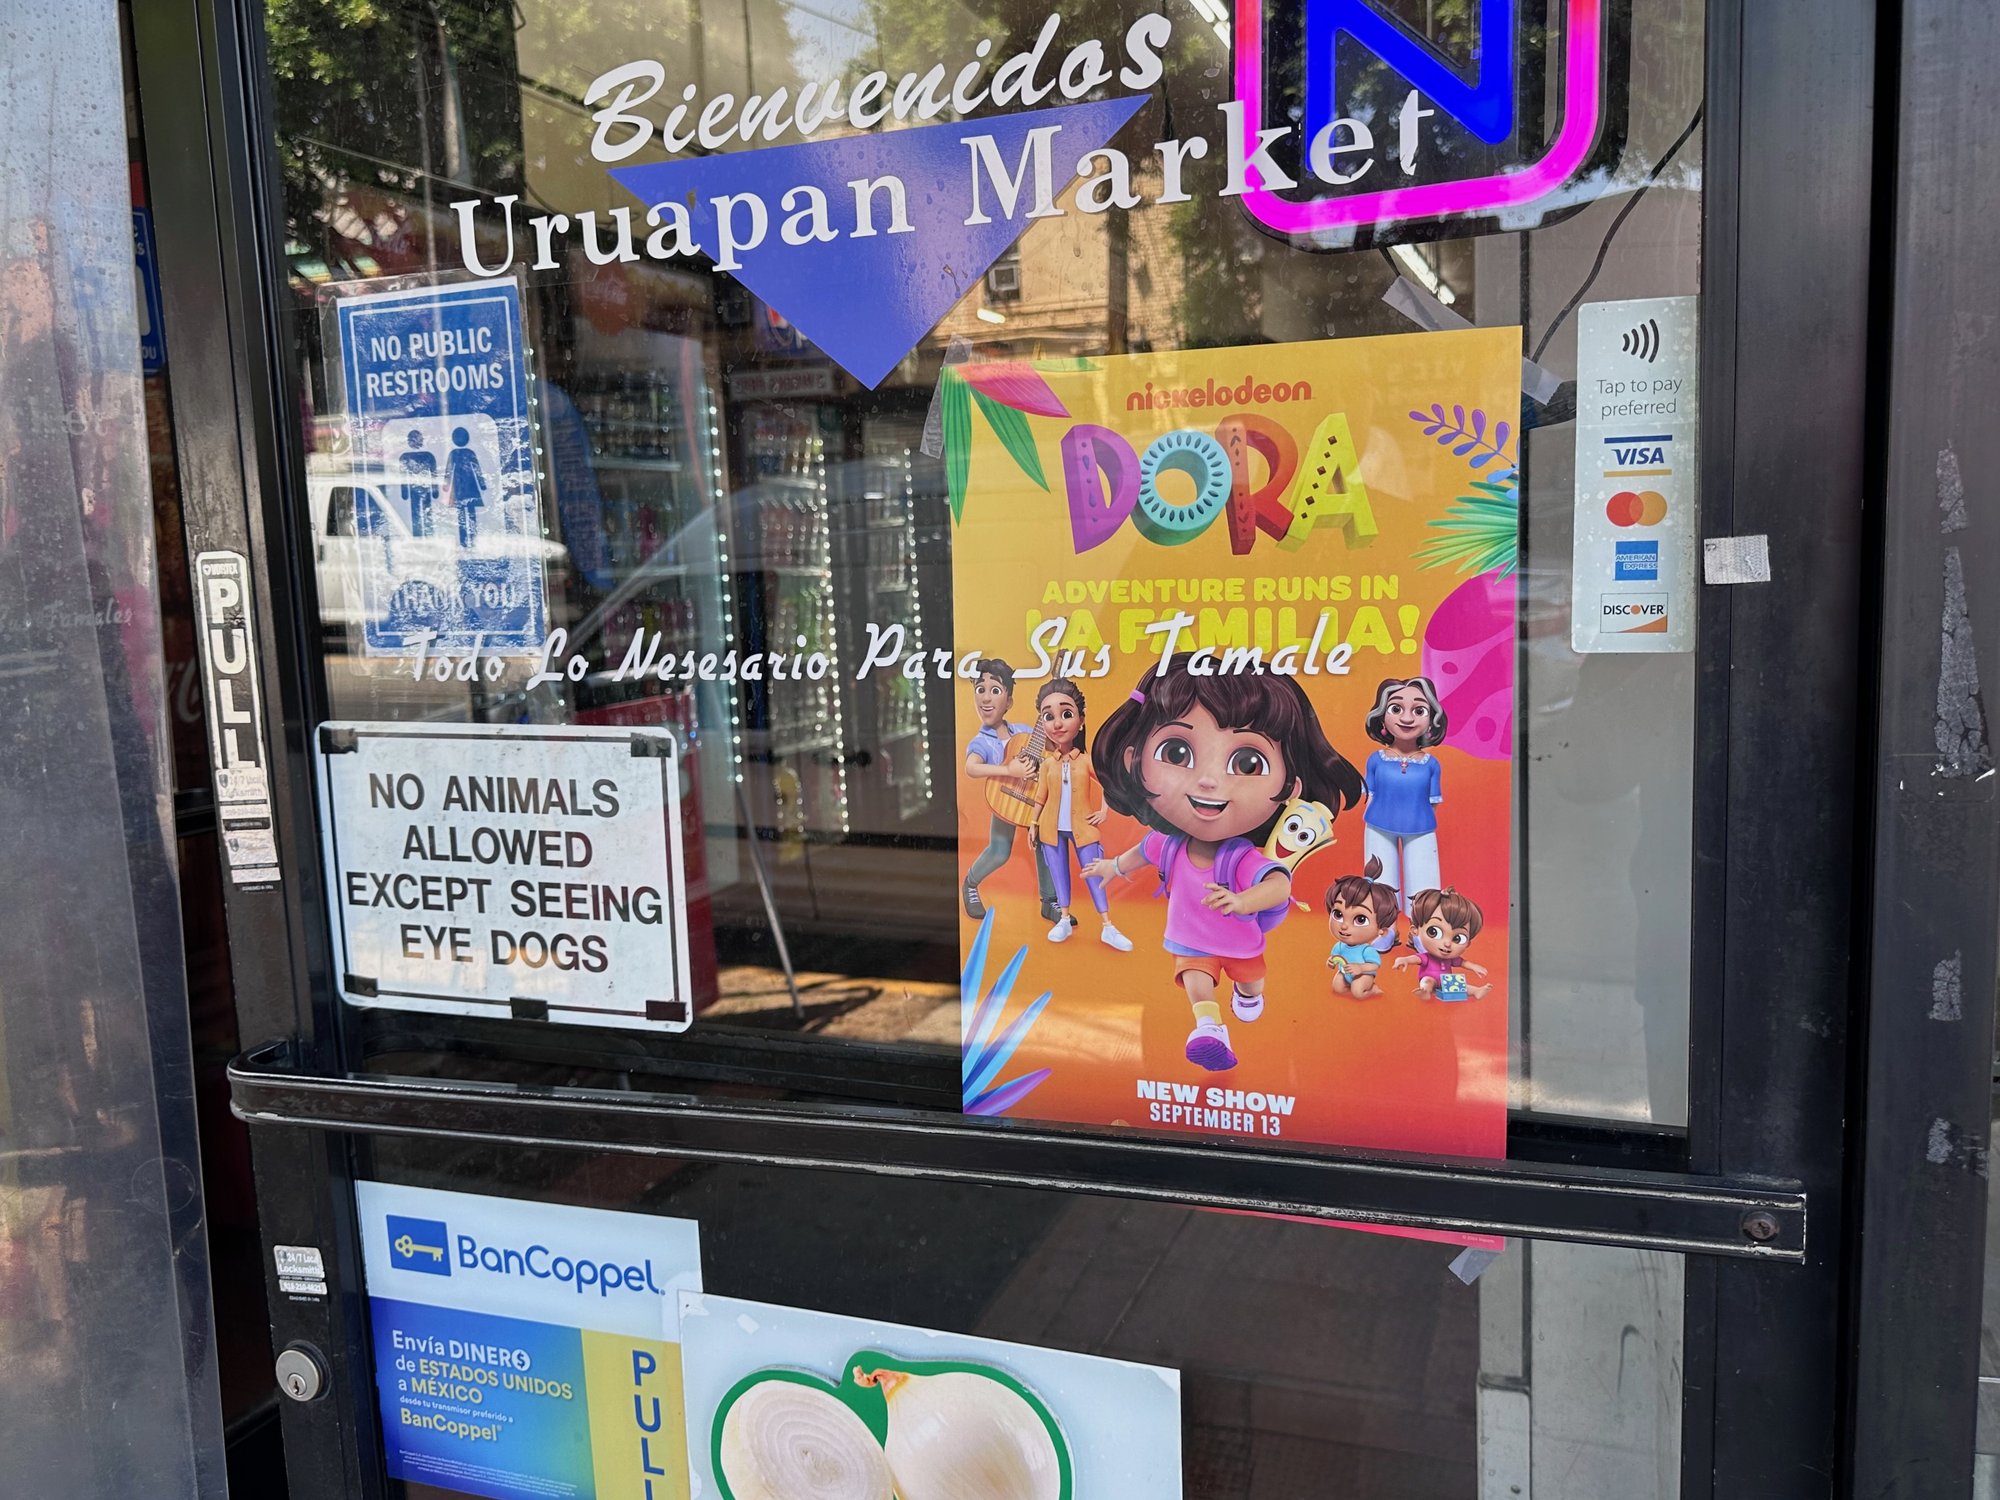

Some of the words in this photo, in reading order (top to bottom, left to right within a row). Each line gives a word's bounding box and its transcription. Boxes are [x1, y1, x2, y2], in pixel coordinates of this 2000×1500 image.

[584, 13, 1172, 163] Bienvenidos
[450, 170, 915, 278] Uruapan
[960, 89, 1435, 227] Market
[370, 336, 402, 363] NO
[409, 327, 492, 358] PUBLIC
[366, 363, 504, 398] RESTROOMS
[1126, 375, 1312, 412] nickelodeon
[1596, 379, 1626, 397] Tap
[1630, 379, 1648, 394] to
[1653, 378, 1683, 395] pay
[1601, 398, 1677, 420] preferred
[1611, 447, 1665, 466] VISA
[1060, 412, 1379, 556] DORA
[1615, 553, 1657, 562] AMERICAN
[1623, 561, 1658, 570] EXPRESS
[470, 581, 517, 608] YOU
[1042, 576, 1246, 605] ADVENTURE
[1254, 574, 1353, 602] RUNS
[1361, 573, 1399, 600] IN
[1603, 604, 1665, 616] DISCOVER
[1118, 604, 1421, 656] FAMILIA!
[403, 626, 505, 682] Todo
[525, 627, 589, 691] Lo
[612, 626, 829, 682] Nesesario
[856, 622, 981, 681] Para
[1011, 616, 1111, 679] Sus
[1144, 611, 1353, 677] Tamale
[206, 577, 256, 768] PULL
[369, 773, 425, 810] NO
[443, 775, 620, 818] ANIMALS
[403, 825, 593, 868] ALLOWED
[346, 871, 492, 914] EXCEPT
[510, 879, 663, 925] SEEING
[400, 924, 473, 963] EYE
[491, 929, 609, 973] DOGS
[1136, 1079, 1199, 1106] NEW
[1206, 1087, 1295, 1116] SHOW
[1149, 1102, 1254, 1134] SEPTEMBER
[1260, 1114, 1281, 1137] 13
[457, 1234, 661, 1297] BanCoppel
[392, 1329, 445, 1356] Envía
[395, 1355, 416, 1373] de
[419, 1358, 499, 1388] ESTADOS
[502, 1372, 573, 1400] UNIDOS
[398, 1379, 407, 1392] a
[411, 1376, 483, 1405] MÉXICO
[400, 1395, 422, 1408] desde
[423, 1398, 431, 1409] tu
[432, 1401, 471, 1416] transmisor
[472, 1408, 507, 1423] preferido
[508, 1416, 514, 1424] a
